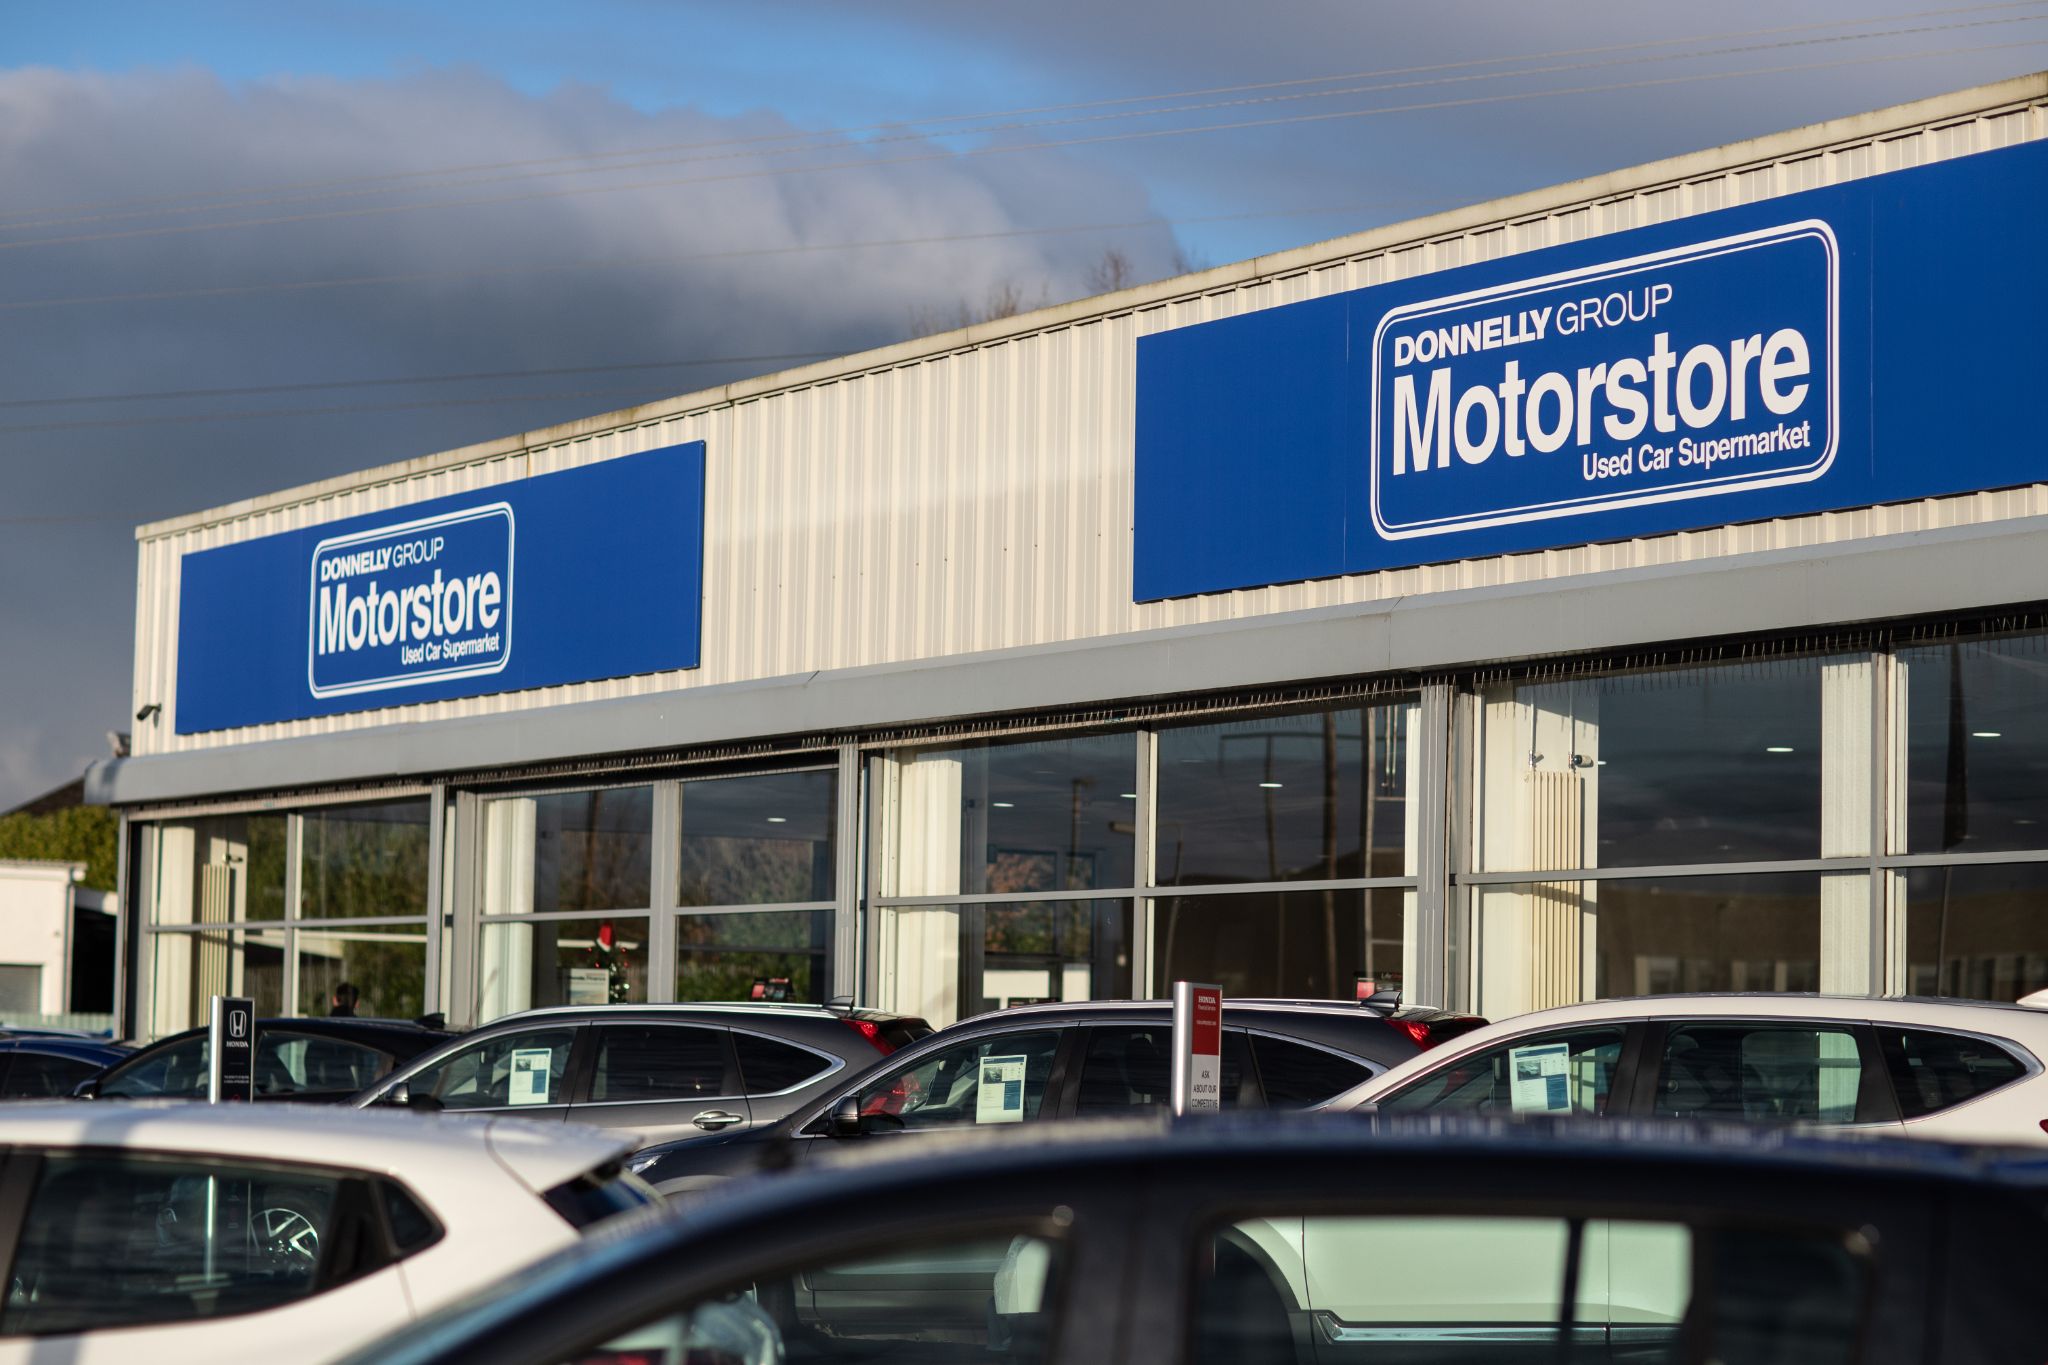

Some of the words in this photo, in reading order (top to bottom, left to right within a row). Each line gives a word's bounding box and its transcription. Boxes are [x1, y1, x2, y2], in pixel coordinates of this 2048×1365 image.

[1394, 307, 1552, 367] DONNELLY
[1556, 283, 1673, 336] GROUP
[1393, 328, 1810, 476] Motorstore
[1583, 449, 1632, 481] Used
[1638, 443, 1674, 473] Car
[1678, 420, 1811, 470] Supermarket
[320, 547, 392, 582] DONNELLY
[393, 536, 444, 568] GROUP
[319, 568, 501, 656] Motorstore
[401, 643, 424, 665] Used
[425, 641, 441, 661] Car
[443, 632, 500, 662] Supermarket
[1198, 995, 1216, 1004] HONDA
[1193, 1084, 1208, 1093] ABOUT
[1208, 1085, 1217, 1094] OUR
[1201, 1070, 1210, 1079] ASK
[1191, 1098, 1218, 1108] COMPETITIVE
